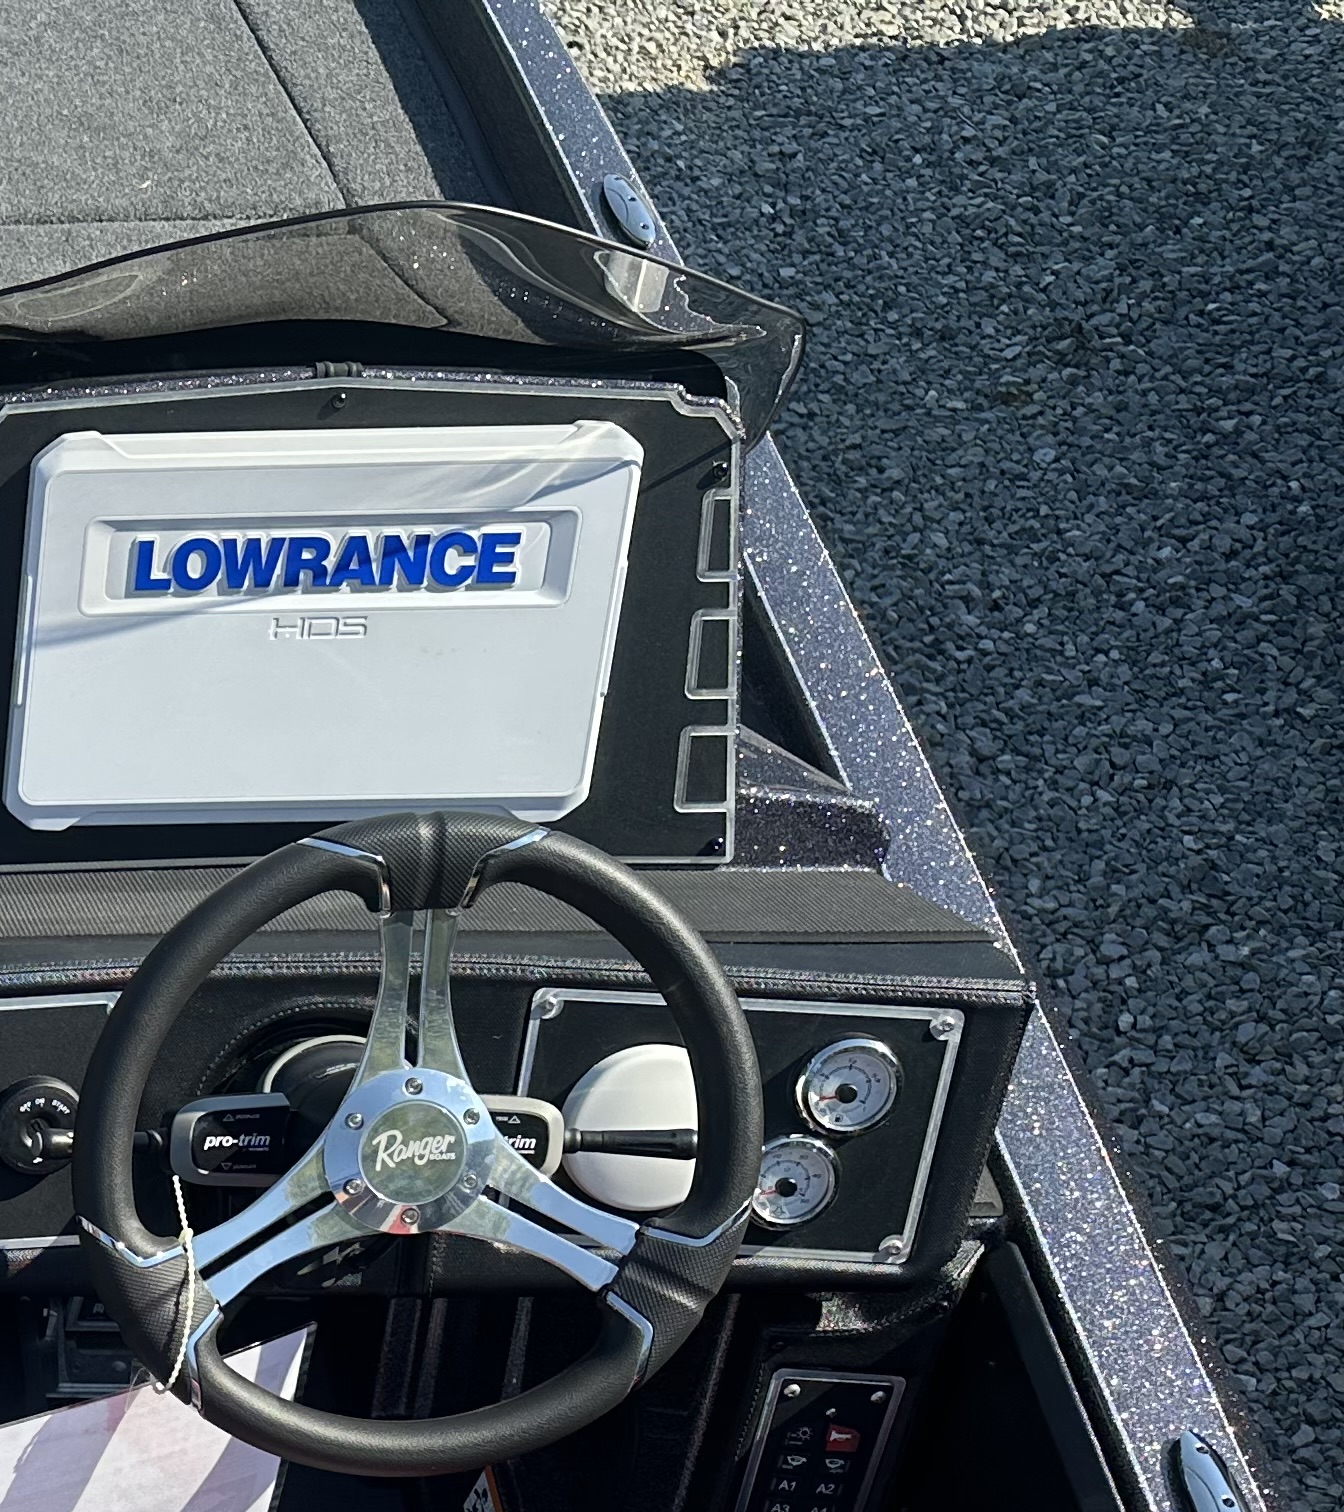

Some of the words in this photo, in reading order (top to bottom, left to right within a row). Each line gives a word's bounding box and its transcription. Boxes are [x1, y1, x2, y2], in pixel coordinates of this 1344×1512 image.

[133, 531, 522, 592] LOWRANCE
[271, 615, 368, 640] HDS
[204, 1132, 271, 1151] pro-trim
[372, 1129, 456, 1172] Ranger
[778, 1479, 797, 1492] A1
[815, 1483, 835, 1495] A2
